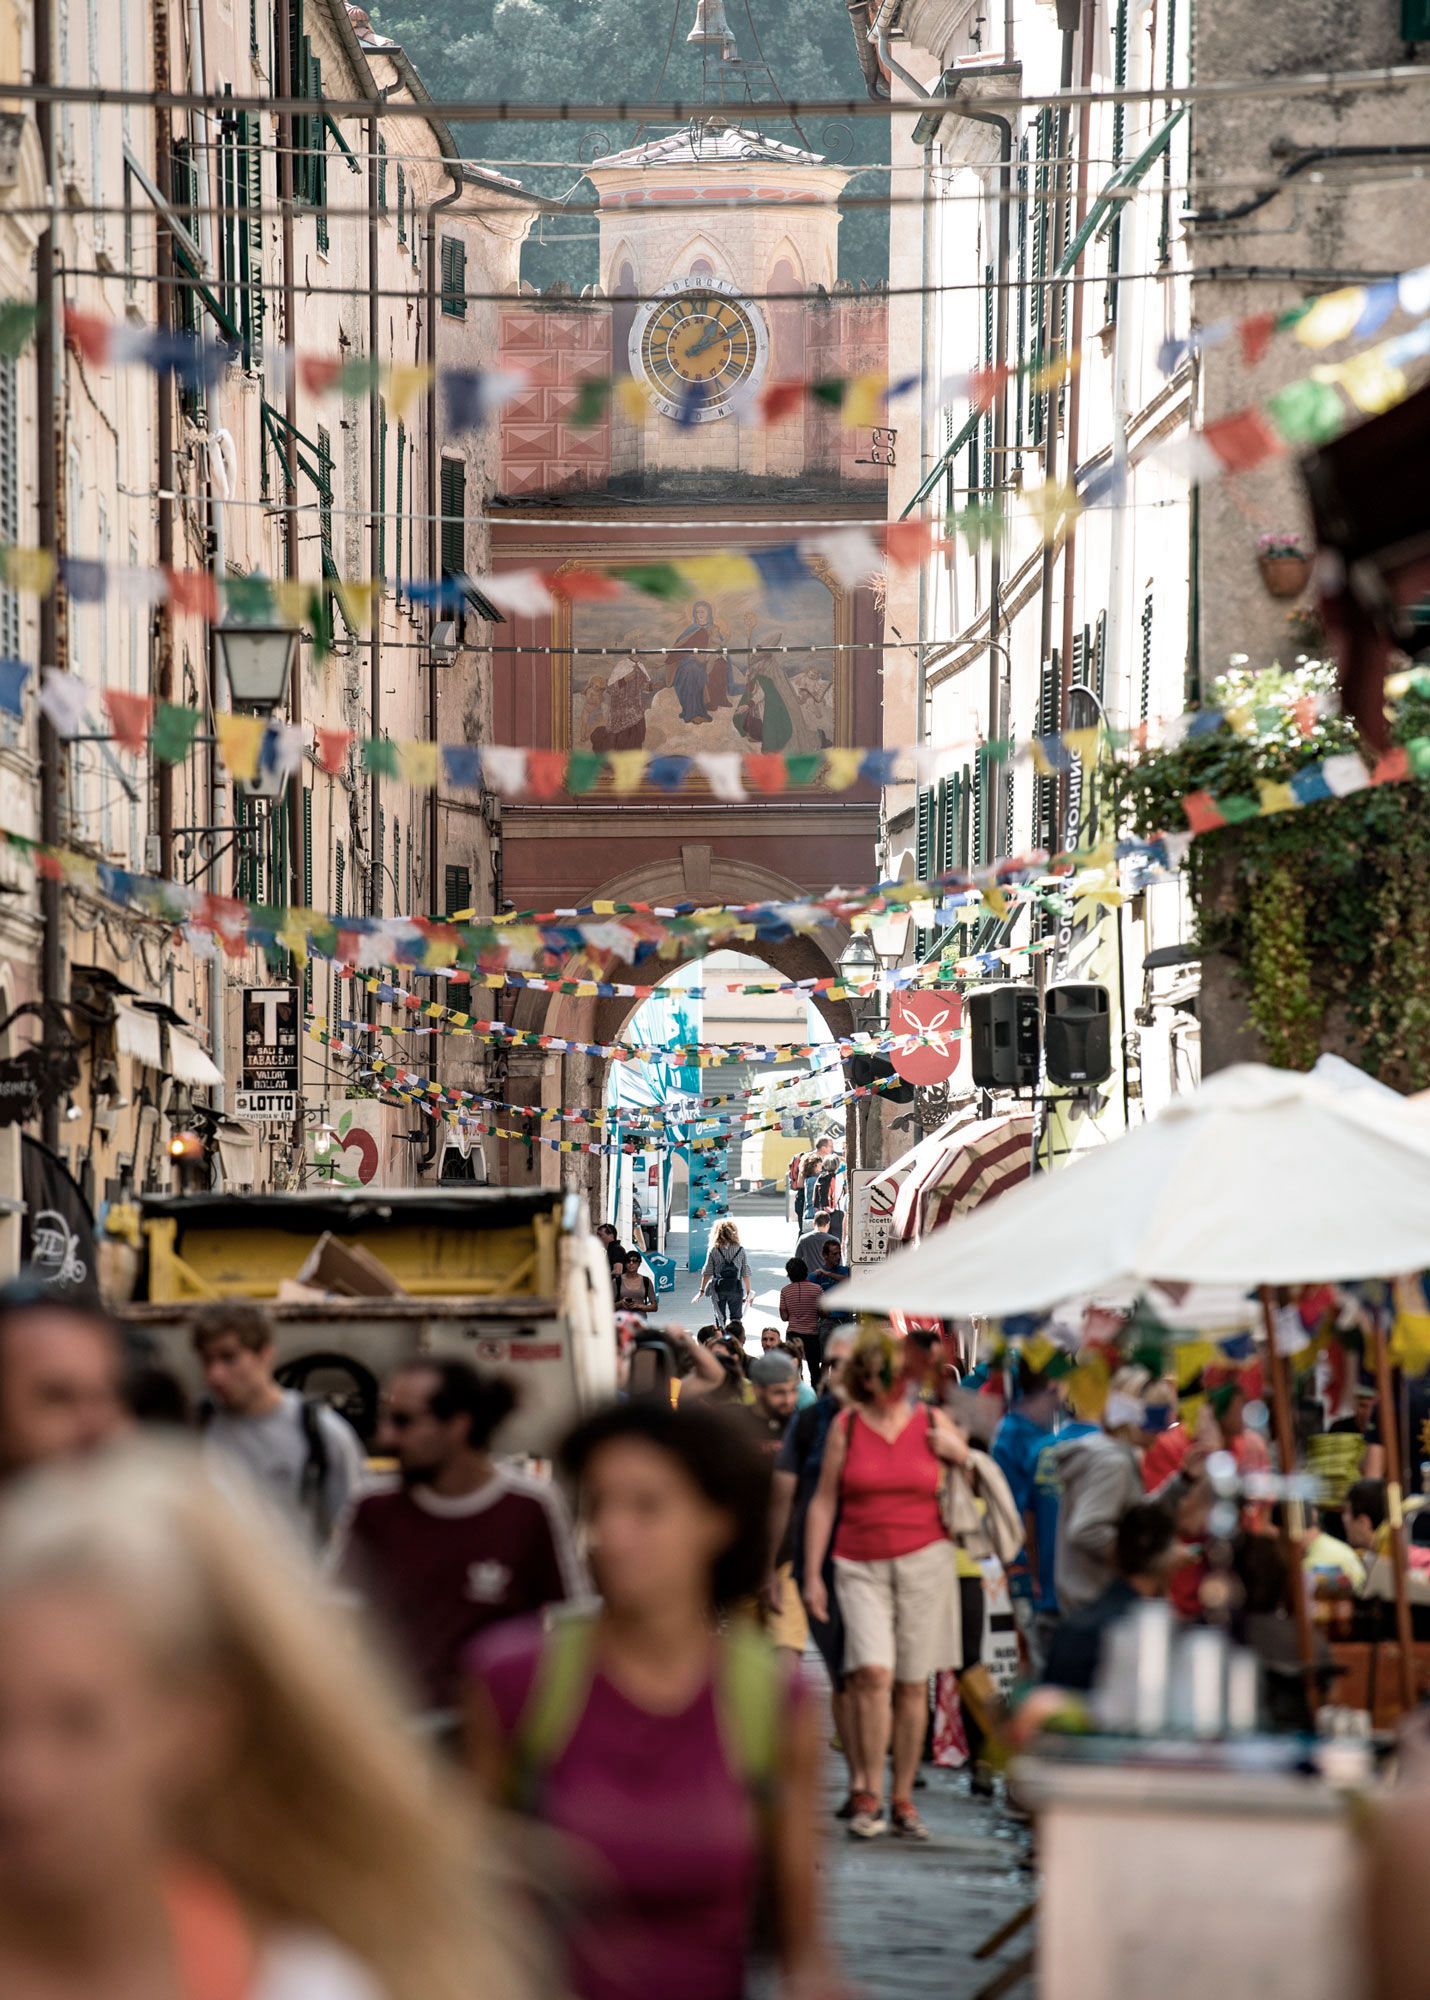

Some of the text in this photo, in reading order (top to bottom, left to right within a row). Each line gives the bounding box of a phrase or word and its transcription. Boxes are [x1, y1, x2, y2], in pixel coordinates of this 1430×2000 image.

[251, 990, 290, 1046] T
[257, 1047, 284, 1055] SALI E
[247, 1055, 294, 1066] TABACCHI
[249, 1095, 293, 1111] LOTTO
